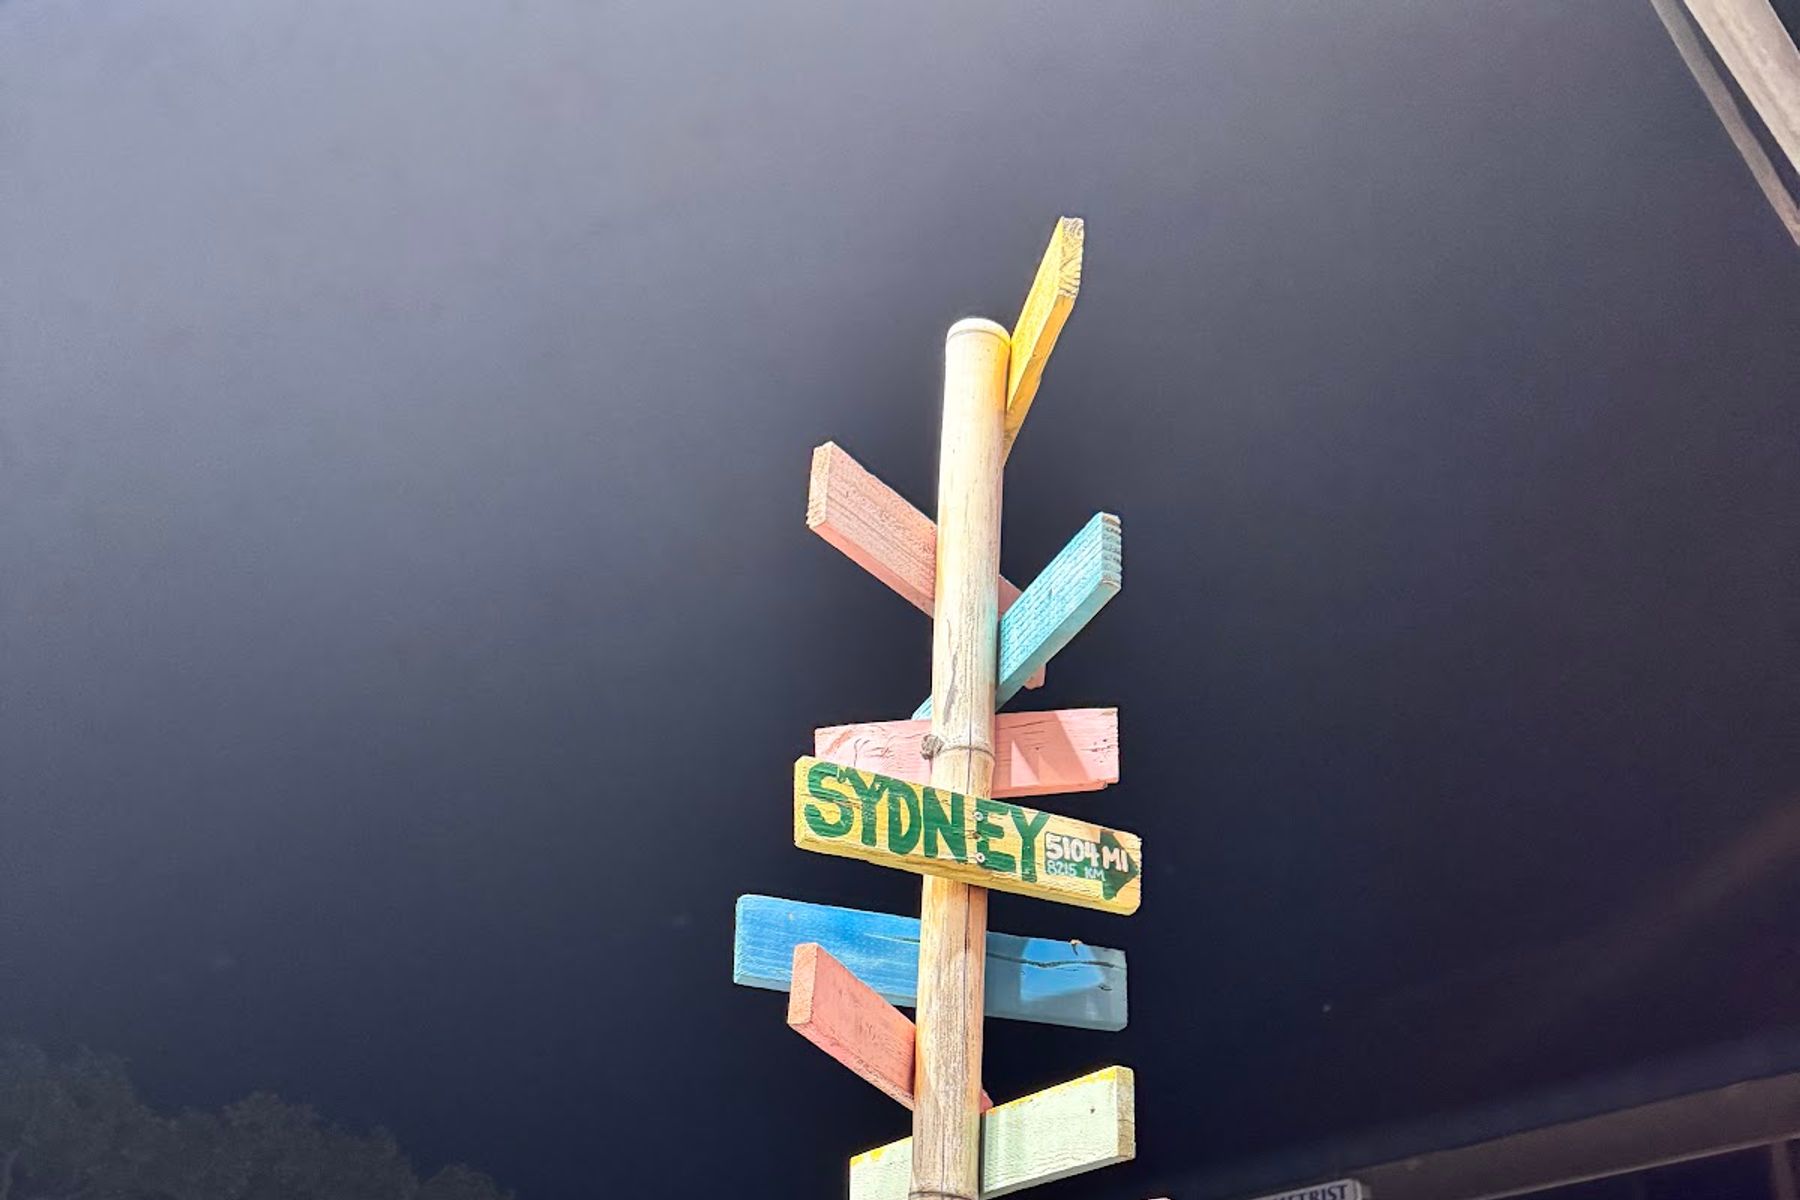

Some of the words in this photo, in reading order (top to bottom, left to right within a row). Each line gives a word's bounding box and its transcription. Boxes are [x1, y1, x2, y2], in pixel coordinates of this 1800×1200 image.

[803, 761, 1051, 884] SYDNEY
[1044, 832, 1100, 868] 5104
[1101, 846, 1129, 873] MI
[1046, 860, 1078, 876] 8215
[1084, 866, 1107, 881] KM
